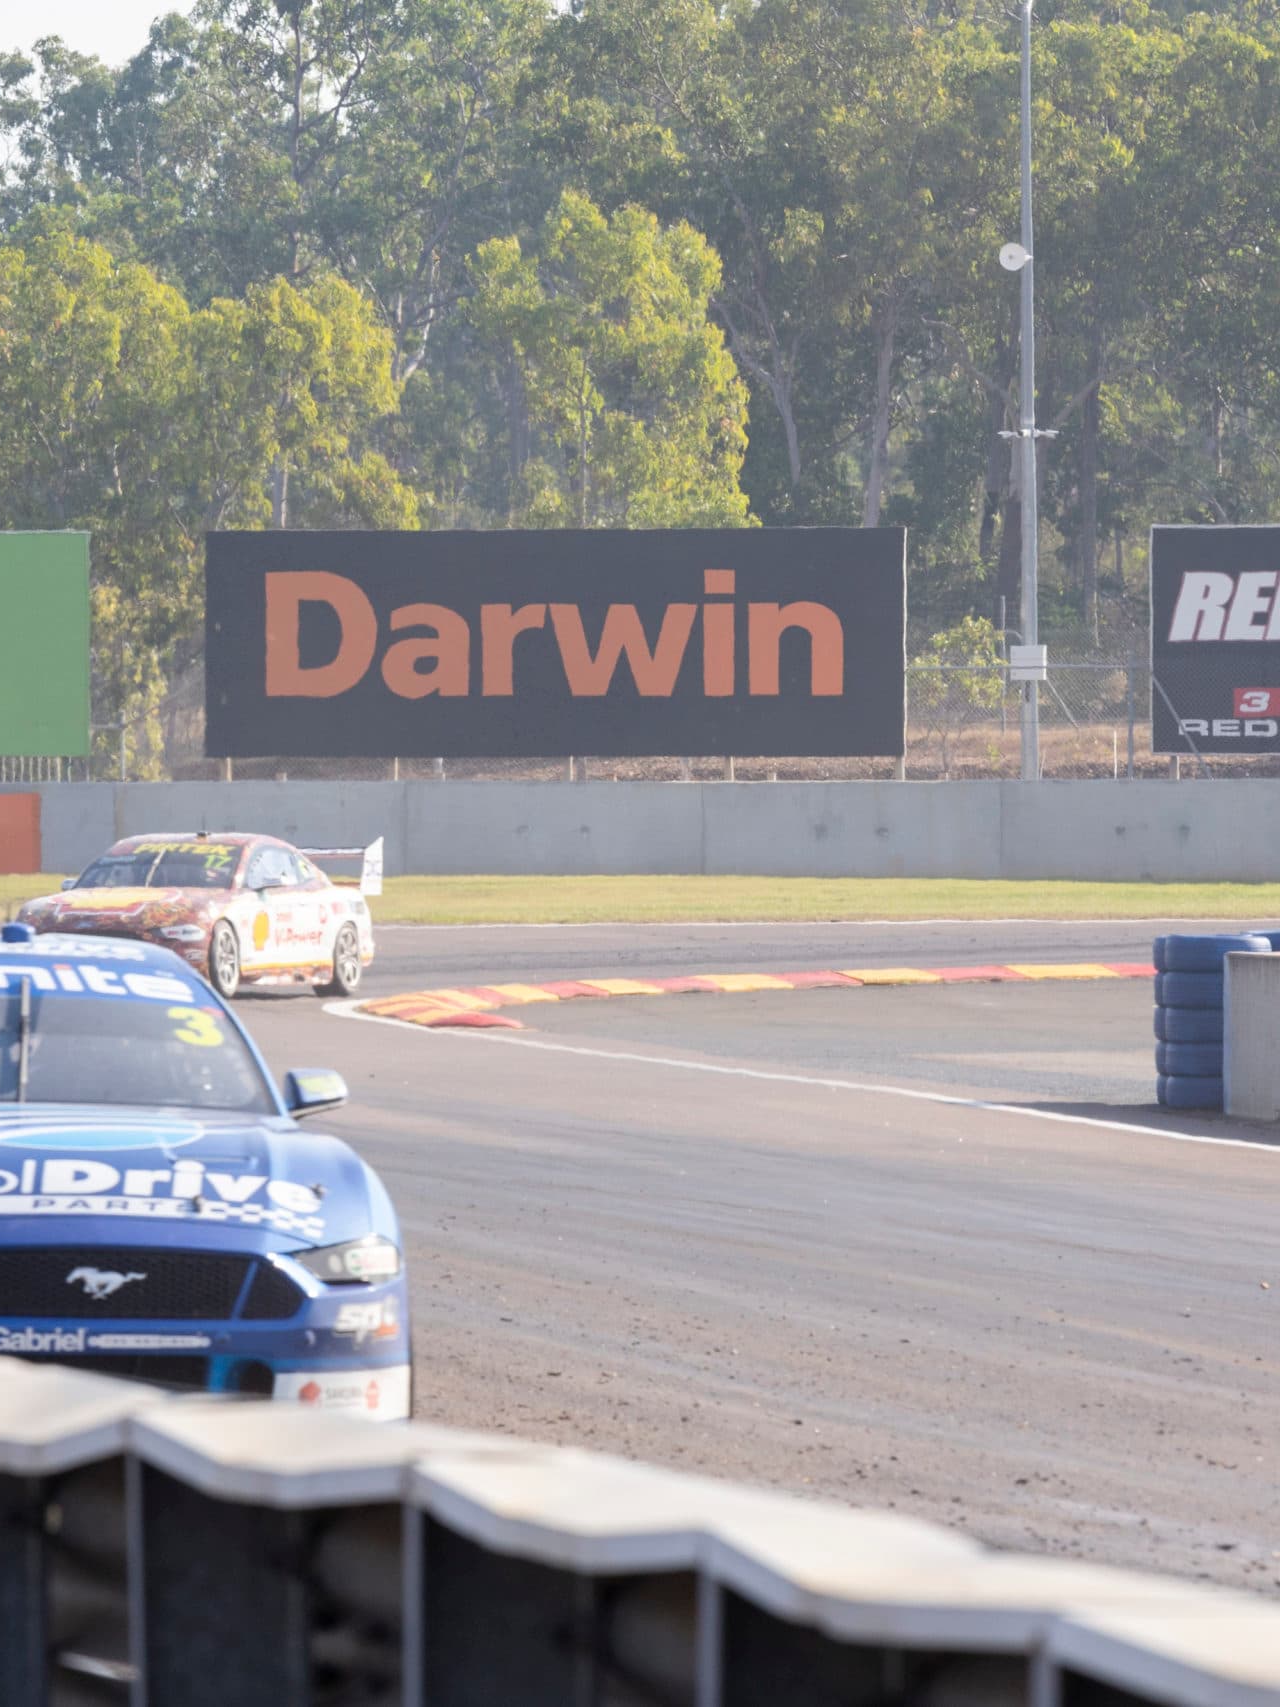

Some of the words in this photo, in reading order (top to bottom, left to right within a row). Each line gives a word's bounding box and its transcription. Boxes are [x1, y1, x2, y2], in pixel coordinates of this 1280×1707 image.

[265, 568, 844, 700] Darwin
[1168, 571, 1280, 641] RE
[167, 1006, 225, 1047] 3
